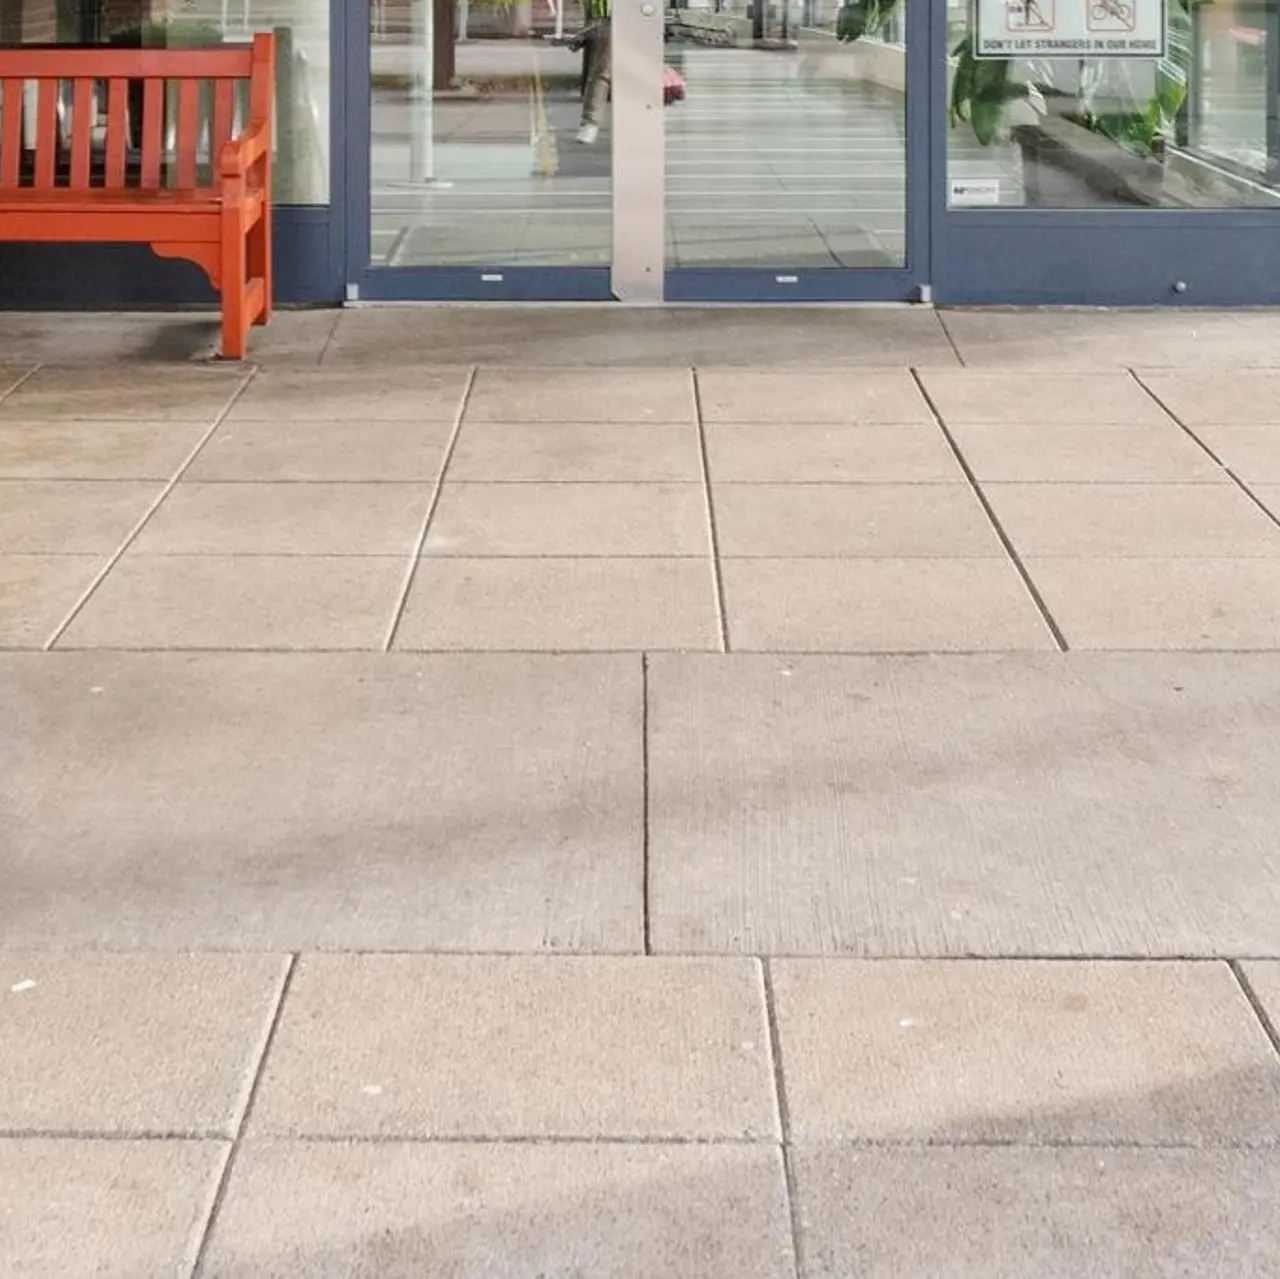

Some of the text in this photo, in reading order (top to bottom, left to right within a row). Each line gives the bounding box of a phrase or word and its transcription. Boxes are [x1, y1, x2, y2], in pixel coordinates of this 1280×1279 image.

[983, 39, 1013, 49] DON'T
[1015, 39, 1033, 49] LET
[1034, 39, 1091, 49] STRANGERS
[1094, 39, 1104, 49] IN
[1107, 39, 1126, 49] OUR
